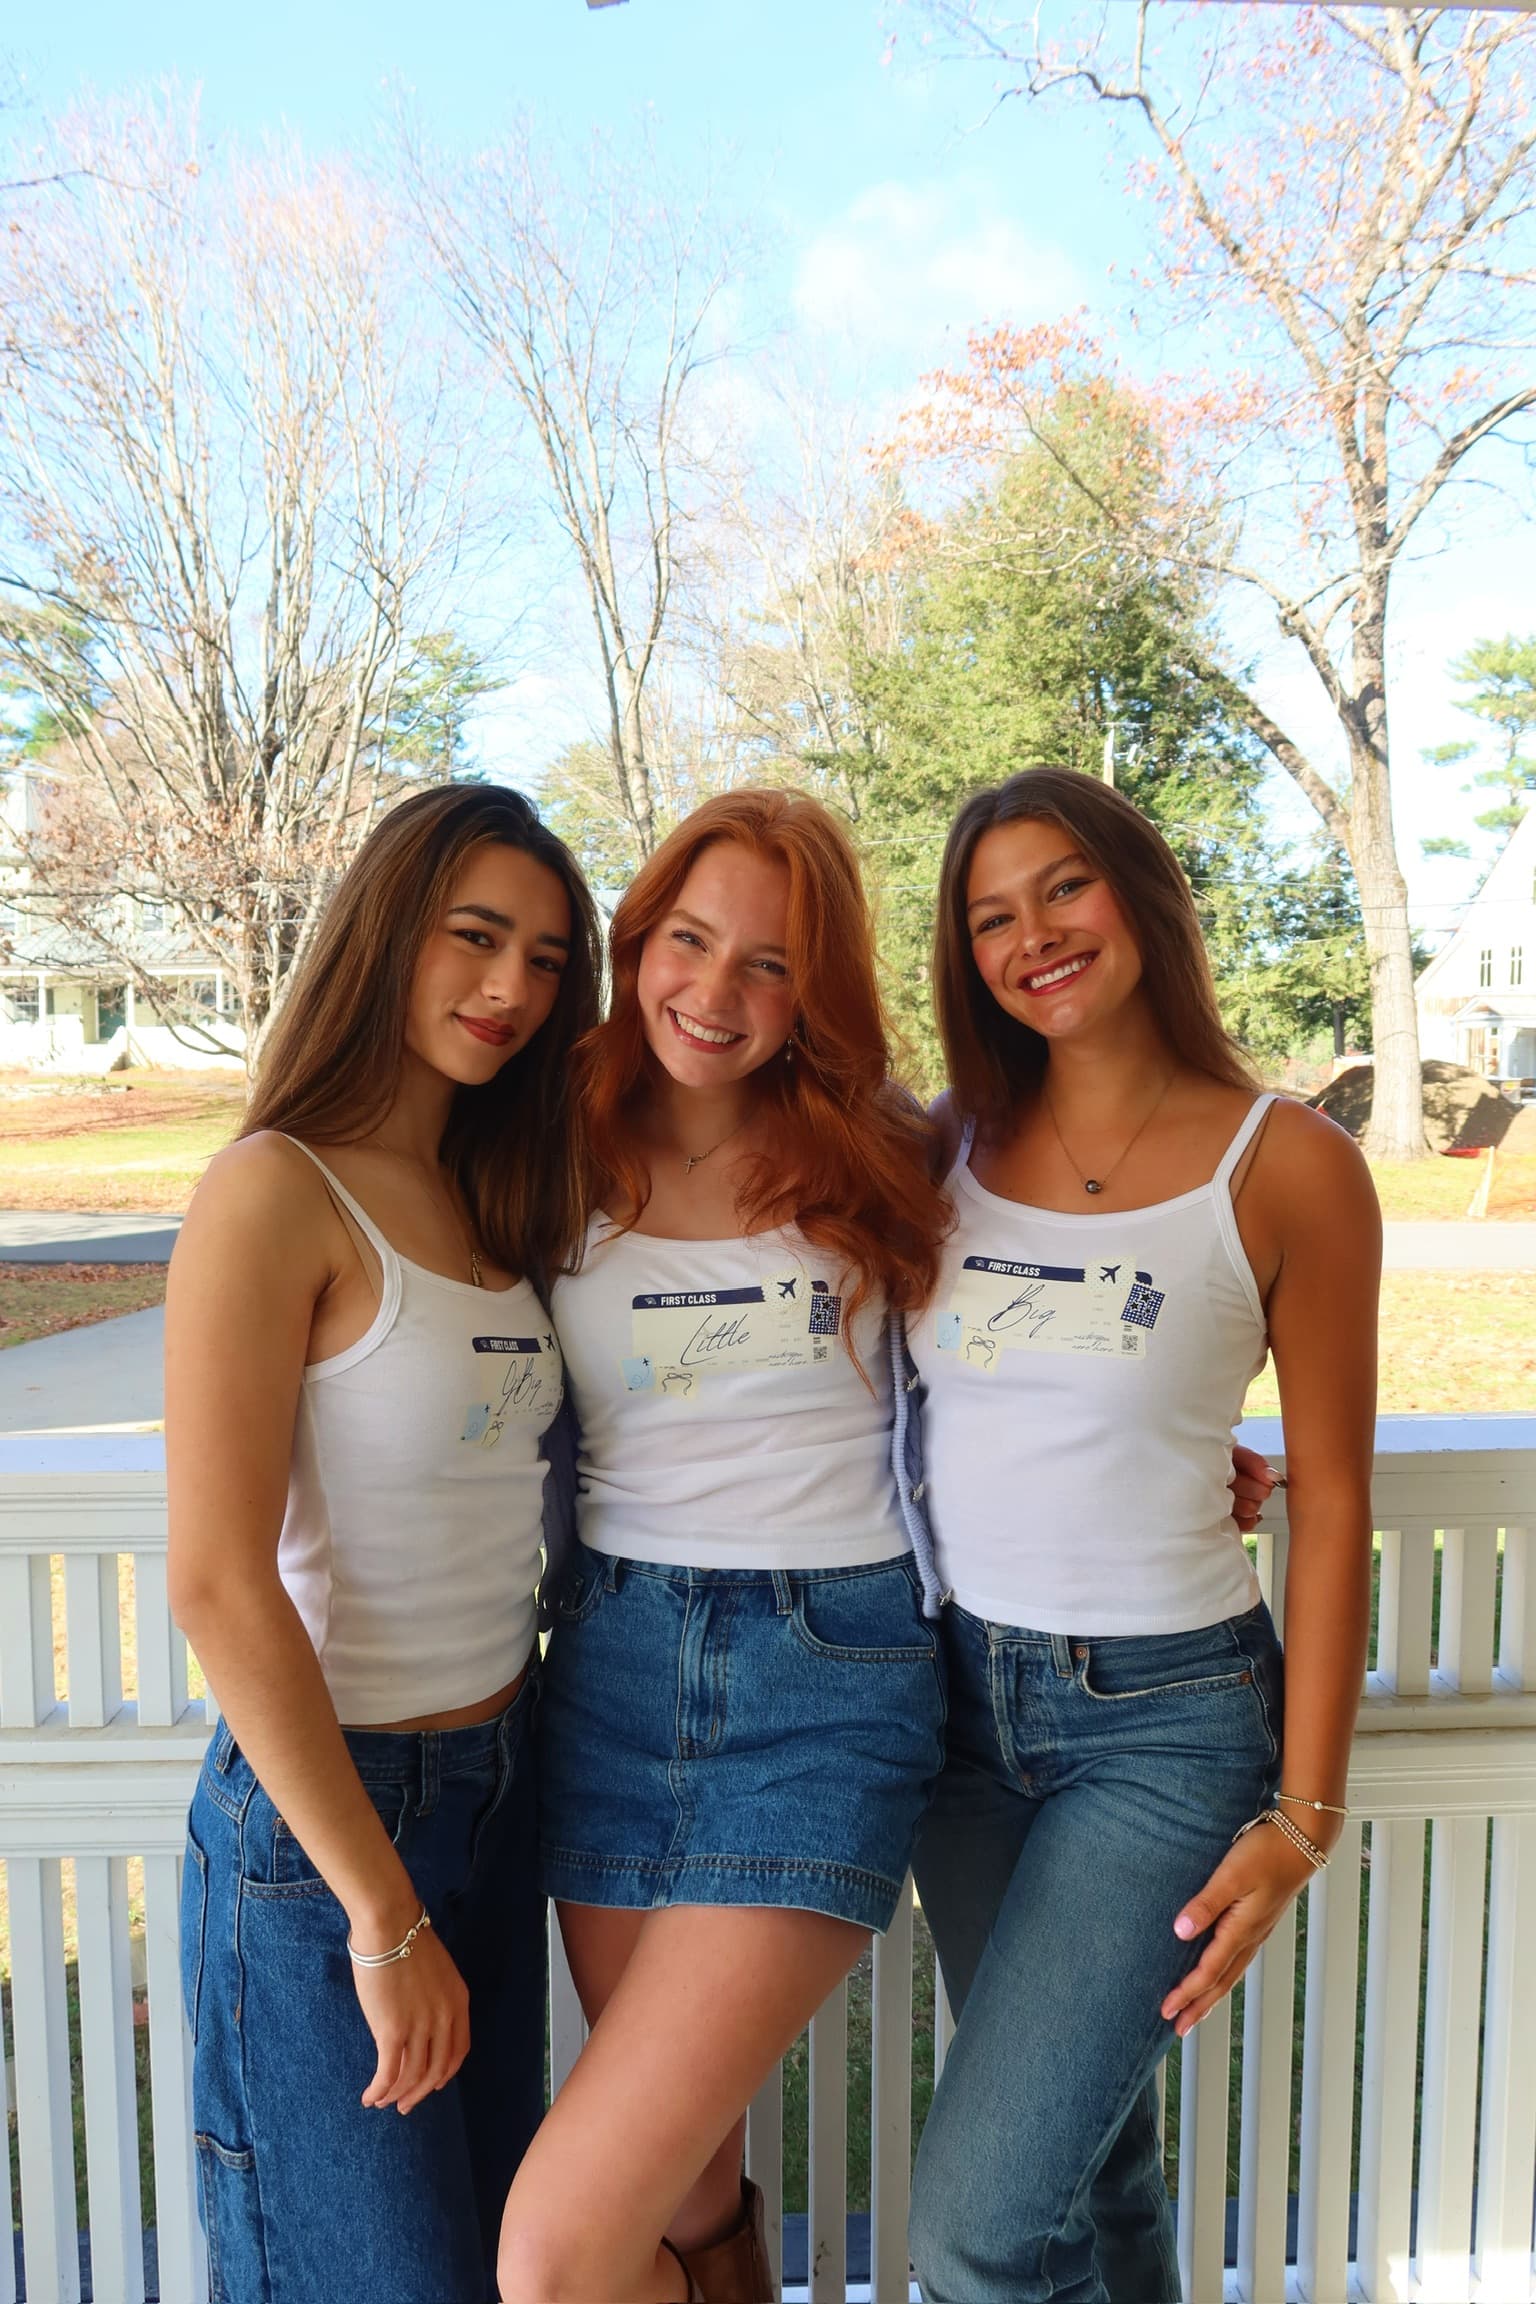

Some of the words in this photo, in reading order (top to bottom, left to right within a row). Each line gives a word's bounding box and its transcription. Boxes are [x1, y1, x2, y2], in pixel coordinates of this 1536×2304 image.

[987, 1261, 1013, 1274] FIRST
[1013, 1263, 1040, 1277] CLASS
[660, 1294, 686, 1306] FIRST
[687, 1293, 717, 1305] CLASS
[987, 1283, 1057, 1339] Big
[489, 1339, 504, 1351] FIRST
[503, 1340, 519, 1351] CLASS
[680, 1313, 751, 1366] Little
